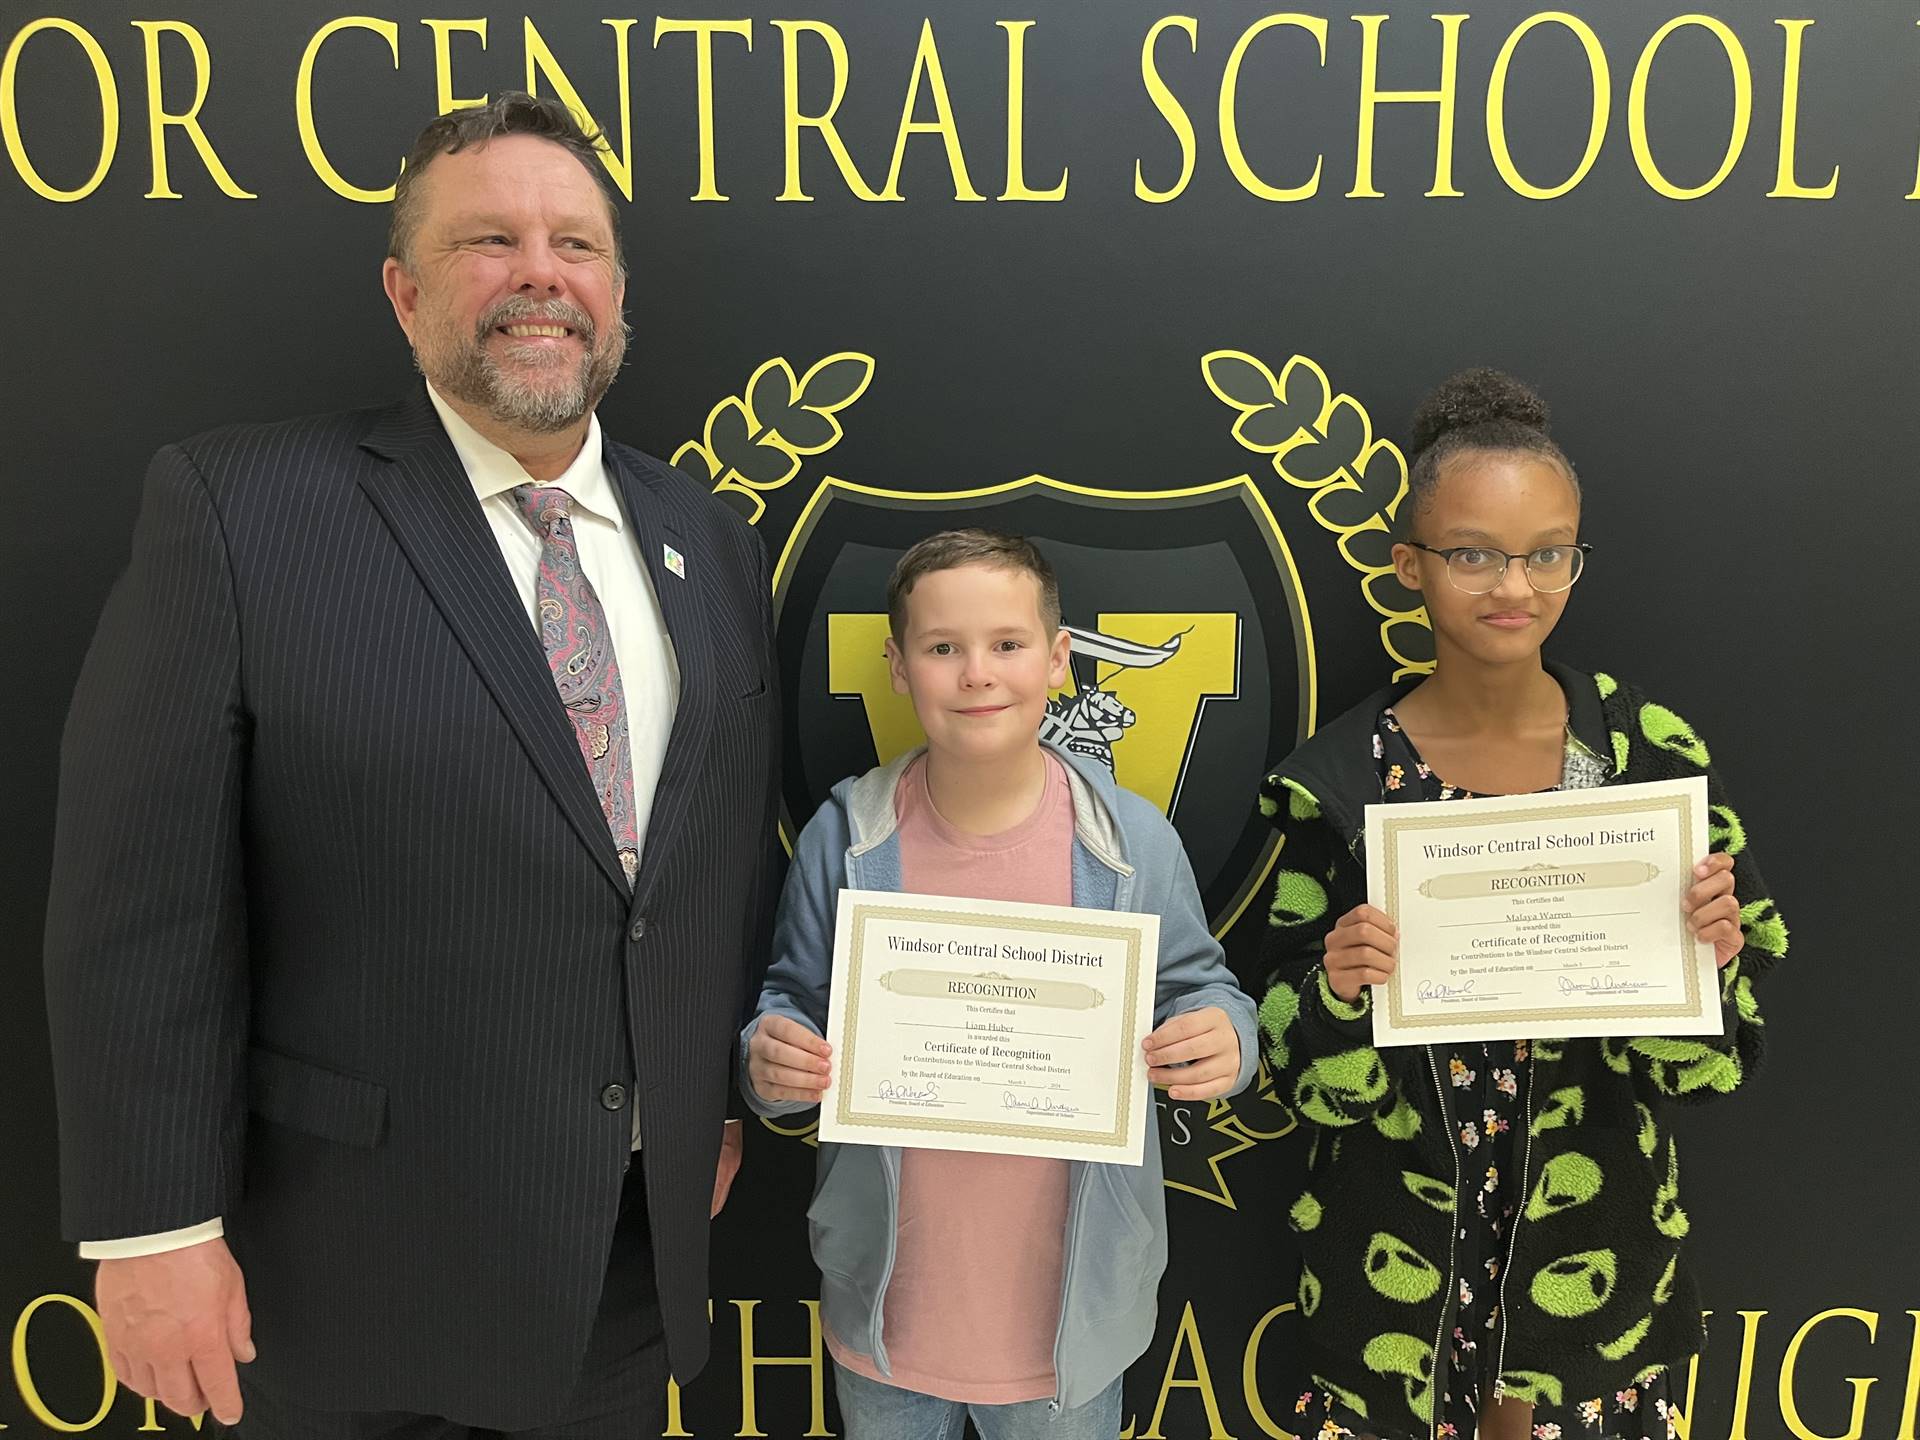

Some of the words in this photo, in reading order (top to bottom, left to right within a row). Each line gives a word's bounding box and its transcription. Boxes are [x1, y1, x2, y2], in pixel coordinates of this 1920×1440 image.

[1134, 11, 1839, 203] SCHOOL
[1424, 843, 1484, 859] Windsor
[1488, 836, 1541, 854] Central
[1546, 832, 1594, 849] School
[1600, 828, 1655, 845] District
[1491, 872, 1586, 891] RECOGNITION
[1526, 896, 1551, 905] Certifies
[1506, 912, 1538, 923] Malaya
[1538, 912, 1572, 920] Warren
[1471, 936, 1528, 949] Certificate
[1530, 934, 1540, 945] of
[1542, 930, 1607, 945] Recognition
[888, 936, 944, 953] Windsor
[948, 940, 998, 958] Central
[1002, 944, 1047, 963] School
[1052, 948, 1104, 968] District
[1461, 951, 1506, 960] Contributions
[1526, 948, 1553, 956] Windsor
[1554, 946, 1579, 954] Central
[1580, 945, 1602, 953] School
[1450, 968, 1457, 976] by
[1469, 966, 1487, 975] Board
[1495, 964, 1527, 973] Education
[948, 981, 1038, 1000] RECOGNITION
[966, 1004, 979, 1013] This
[979, 1006, 1003, 1015] Certifies
[1004, 1008, 1016, 1016] that
[965, 1020, 986, 1031] Liam
[988, 1022, 1014, 1033] Huber
[974, 1034, 999, 1042] awarded
[924, 1040, 977, 1055] Certificate
[980, 1046, 990, 1056] of
[992, 1046, 1051, 1061] Recognition
[903, 1054, 913, 1062] for
[913, 1056, 955, 1065] Contributions
[974, 1060, 1000, 1068] Windsor
[1001, 1062, 1025, 1071] Central
[1025, 1064, 1047, 1072] School
[1048, 1066, 1071, 1075] District
[901, 1070, 909, 1079] by
[909, 1070, 919, 1078] the
[918, 1070, 937, 1079] Board
[944, 1072, 973, 1081] Education
